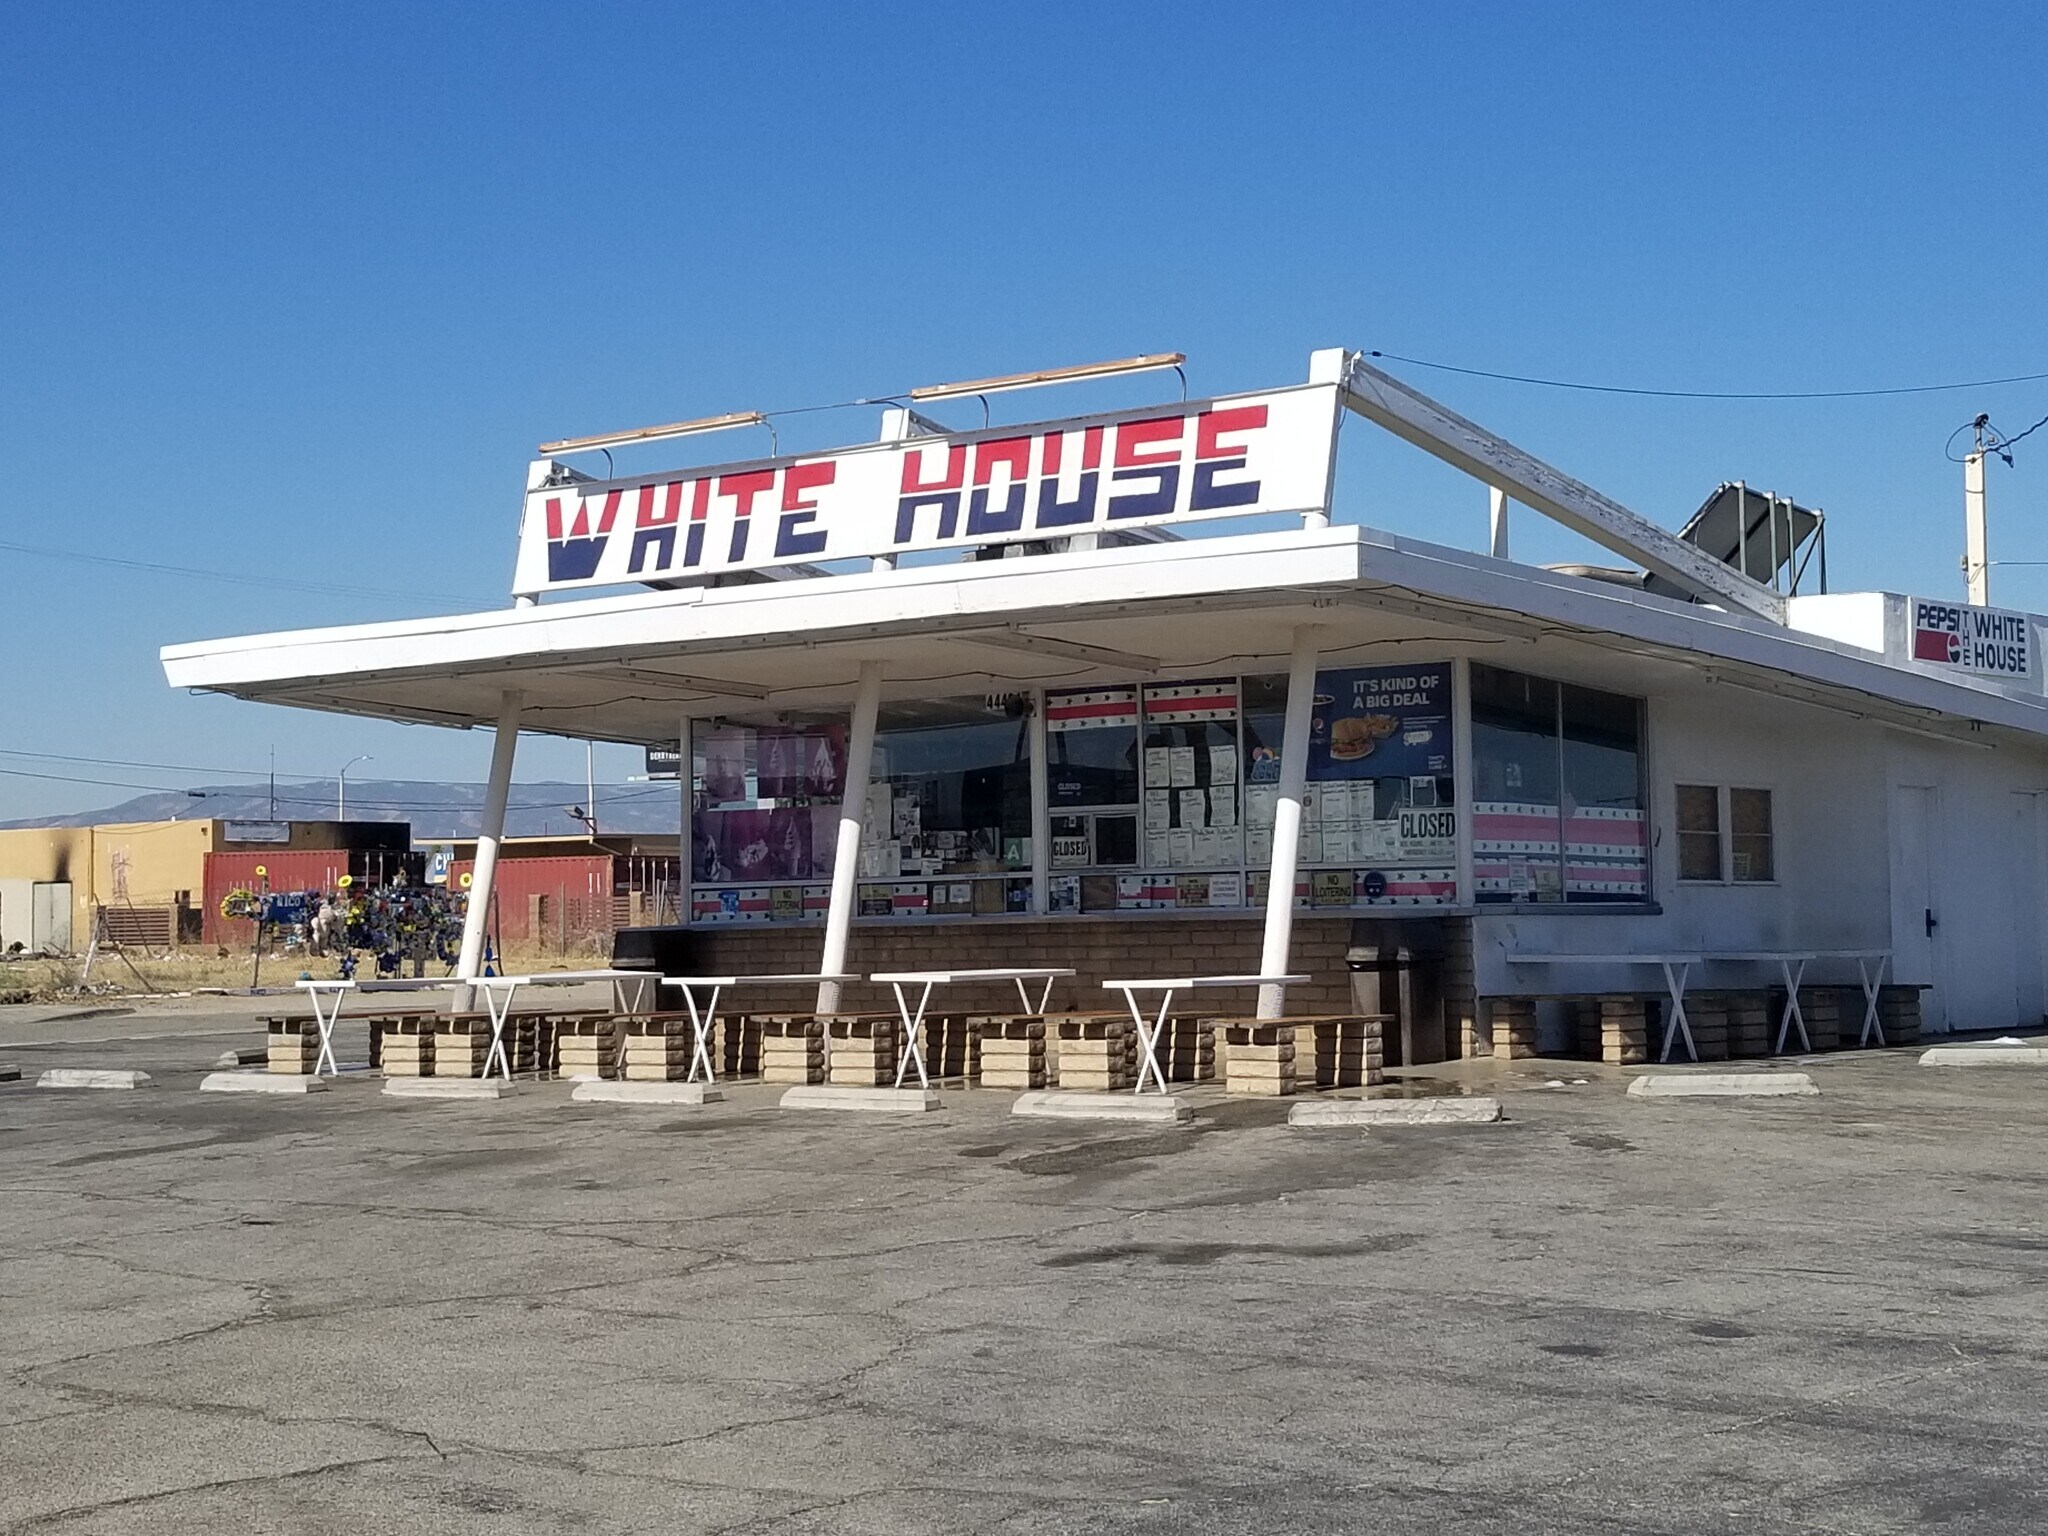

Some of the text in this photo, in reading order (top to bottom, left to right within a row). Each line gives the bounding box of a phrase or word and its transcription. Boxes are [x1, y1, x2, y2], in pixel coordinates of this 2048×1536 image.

[546, 404, 1268, 582] WHITE HOUSE
[1917, 604, 1960, 632] PEPSI
[1973, 612, 2025, 643] WHITE
[1974, 642, 2026, 672] HOUSE
[1352, 675, 1439, 694] IT'S KIND OF
[1352, 692, 1430, 709] A BIG DEAL
[1401, 812, 1456, 839] CLOSED
[1007, 844, 1019, 860] A
[1053, 840, 1087, 856] CLOSED
[1327, 875, 1339, 885] NO
[277, 896, 301, 907] NICO
